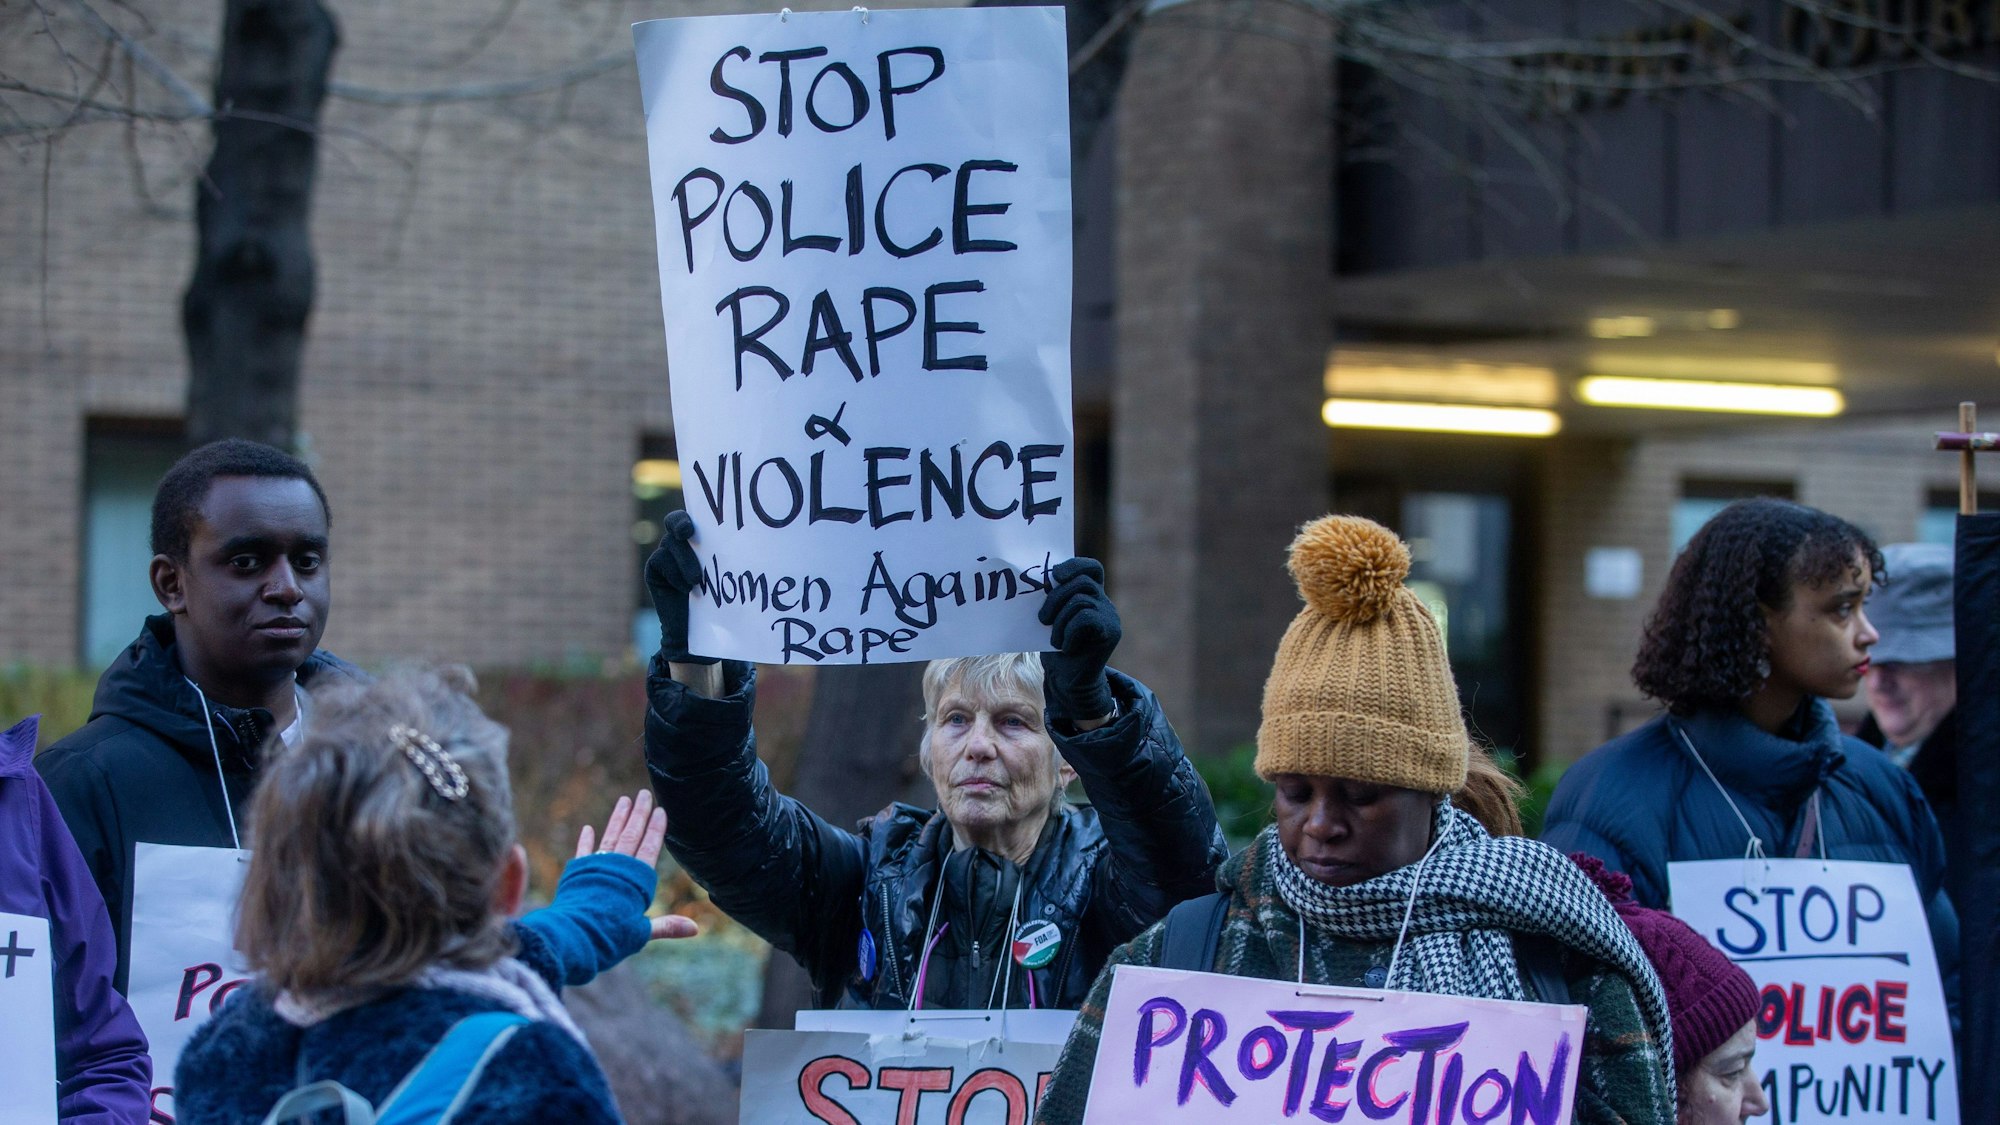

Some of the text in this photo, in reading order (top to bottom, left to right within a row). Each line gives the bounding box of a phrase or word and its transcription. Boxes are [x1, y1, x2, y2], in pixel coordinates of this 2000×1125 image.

[709, 45, 946, 144] STOP
[671, 159, 1019, 274] POLICE
[715, 280, 989, 392] RAPE
[693, 440, 1065, 531] VIOLENCE
[701, 550, 1054, 630] Women Against
[771, 617, 919, 665] Rape
[1034, 934, 1049, 947] FOA
[1716, 883, 1885, 955] STOP
[1756, 980, 1908, 1047] OLICE
[798, 1055, 1054, 1125] STO
[1133, 996, 1573, 1125] PROTECTION
